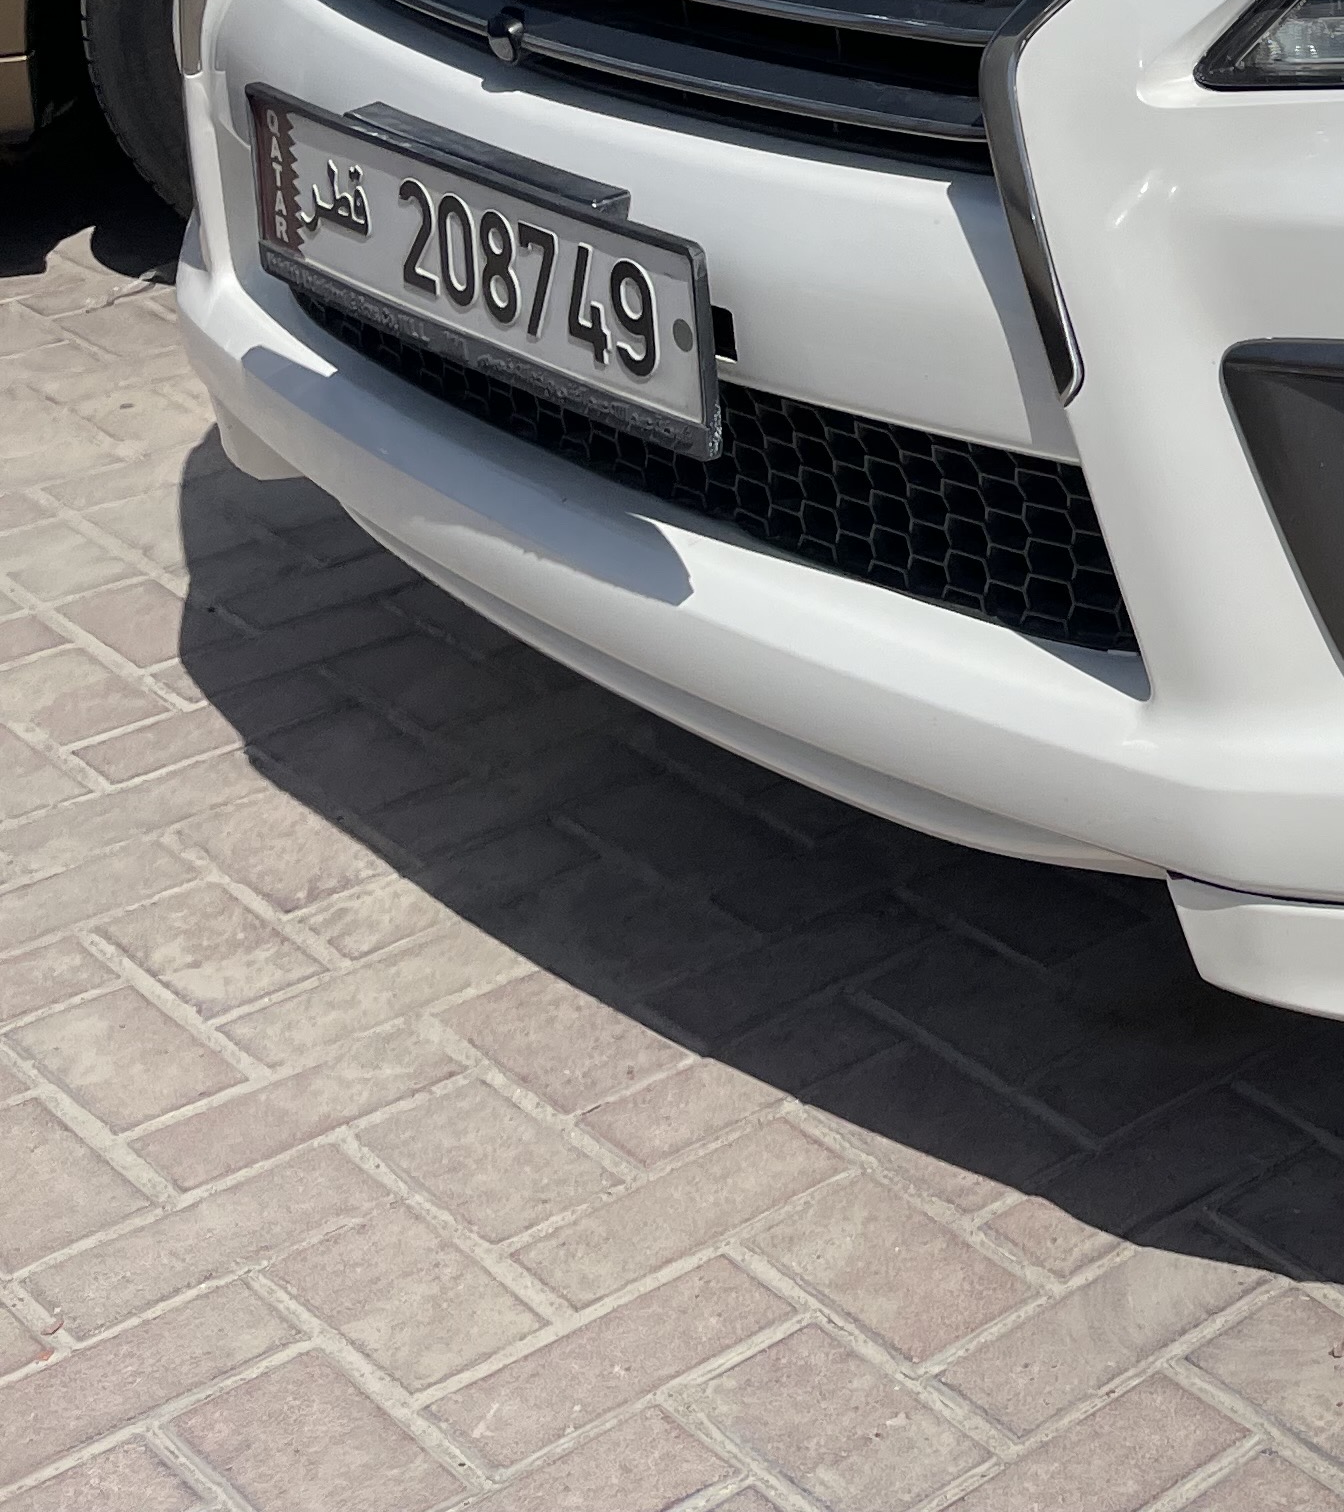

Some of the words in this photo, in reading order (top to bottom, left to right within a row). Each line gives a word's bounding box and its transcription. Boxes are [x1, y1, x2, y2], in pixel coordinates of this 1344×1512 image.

[264, 108, 290, 245] QATAR
[300, 159, 372, 238] قطر
[398, 177, 661, 382] 208749
